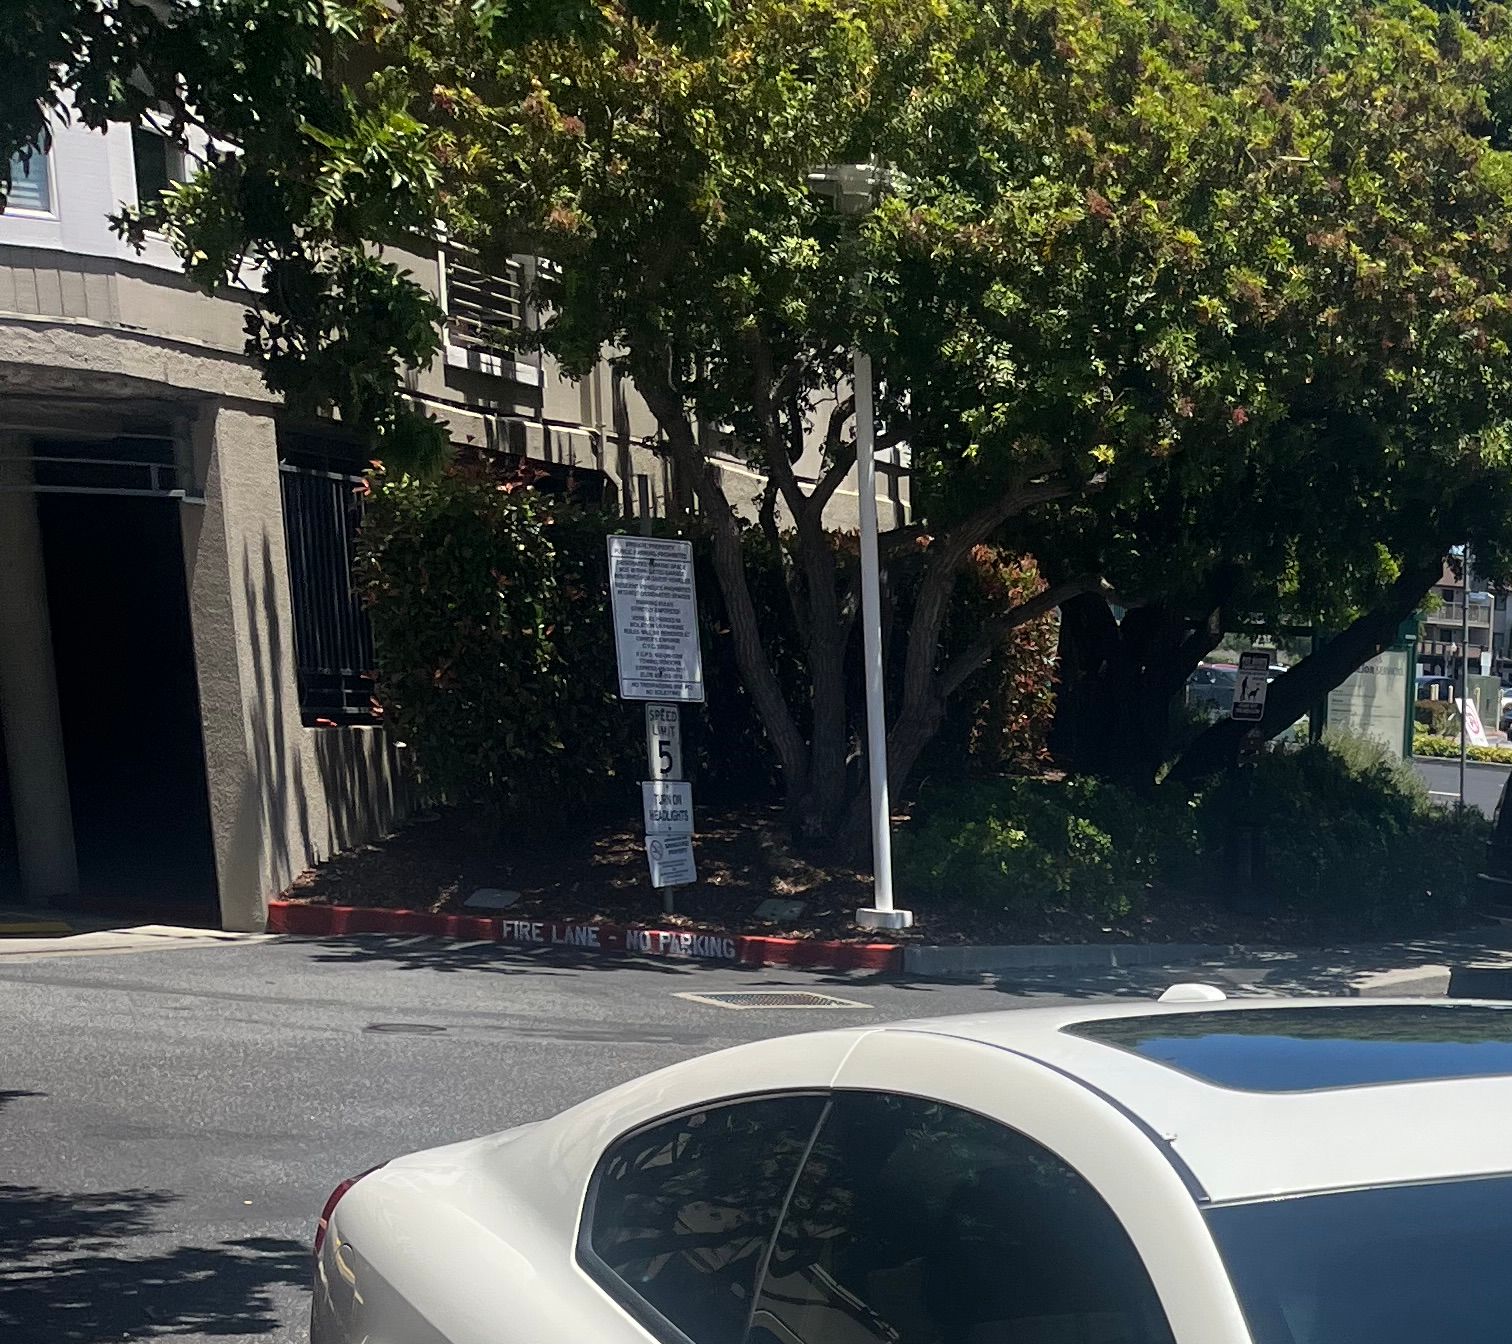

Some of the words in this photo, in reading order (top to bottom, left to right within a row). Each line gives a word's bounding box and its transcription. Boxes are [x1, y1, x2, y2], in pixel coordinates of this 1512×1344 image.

[649, 708, 677, 722] SPEED
[652, 725, 676, 737] LIMIT
[658, 740, 673, 774] 5
[654, 794, 672, 806] TURN
[672, 794, 682, 806] ON
[649, 809, 689, 823] HEADLIGHTS
[502, 919, 544, 942] FIRE
[551, 924, 600, 947] LANE
[626, 929, 652, 952] NO
[659, 931, 736, 959] PARKING
